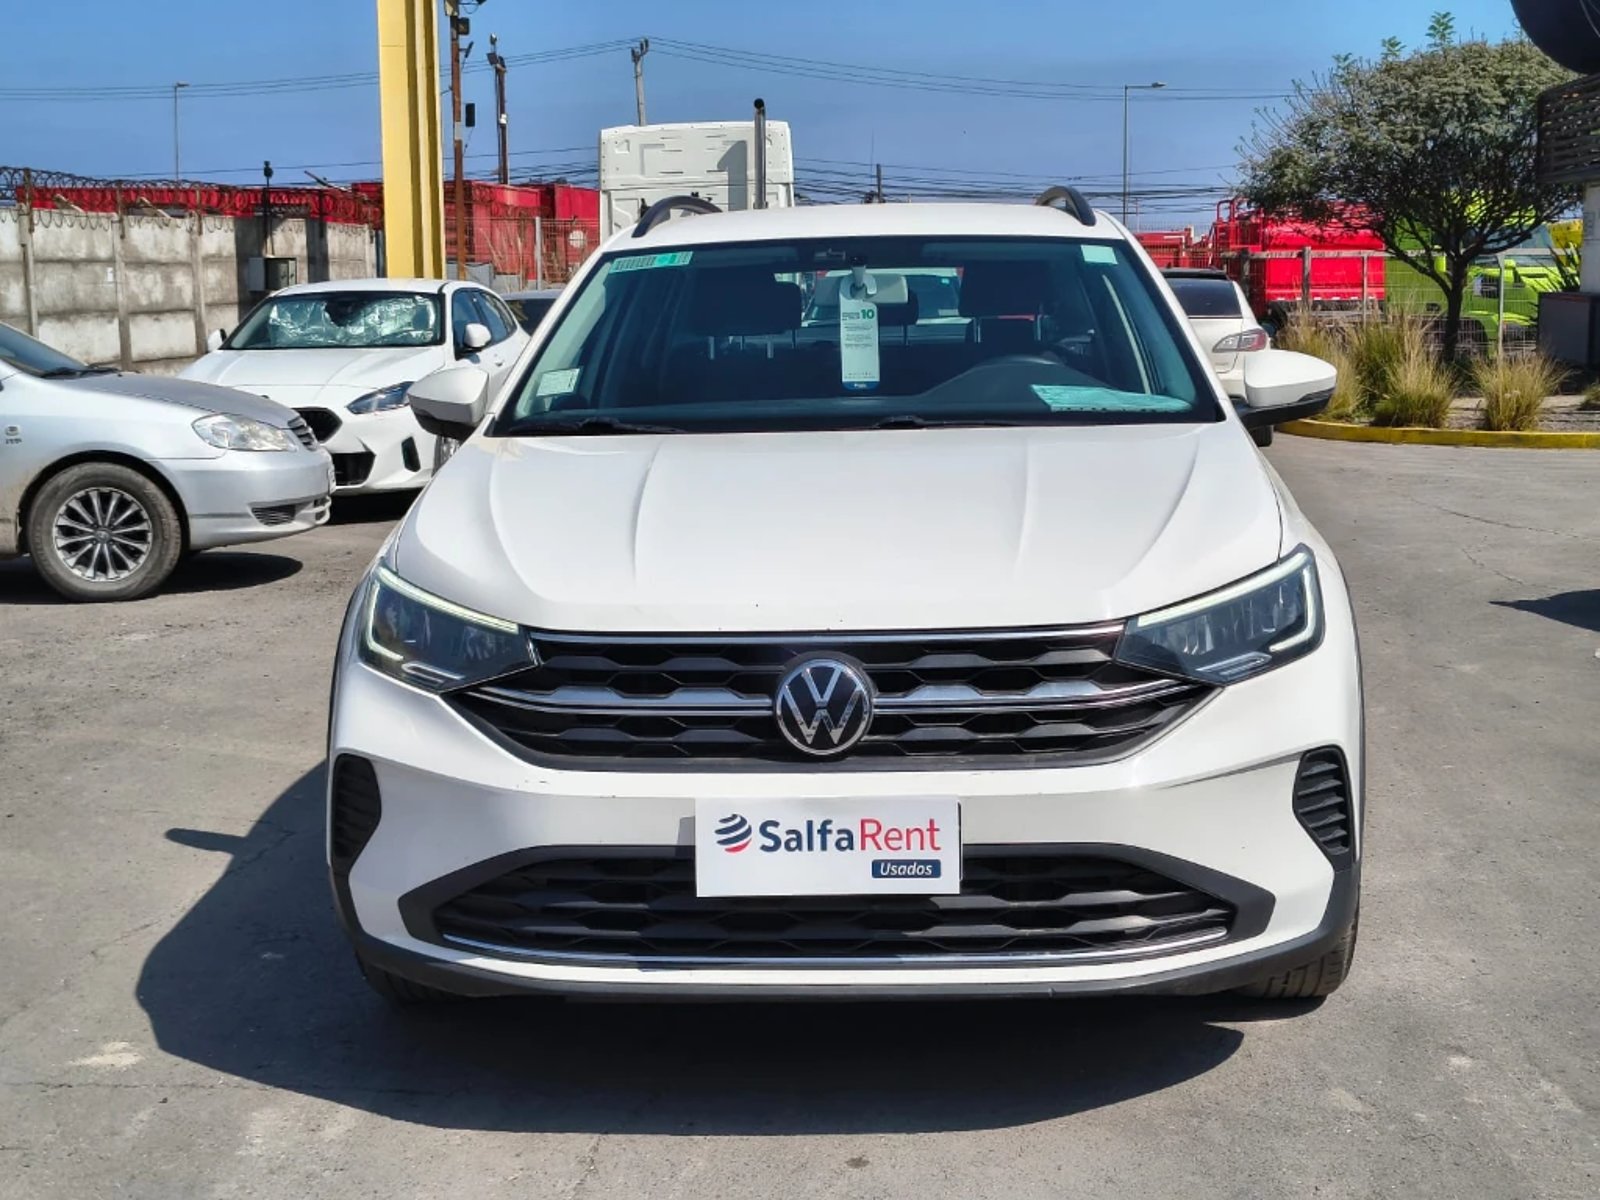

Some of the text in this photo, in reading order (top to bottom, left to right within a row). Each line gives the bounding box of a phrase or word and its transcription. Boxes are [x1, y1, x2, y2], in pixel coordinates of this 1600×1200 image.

[861, 309, 875, 319] 10
[759, 818, 941, 852] SalfaRent
[880, 862, 932, 876] Usados
